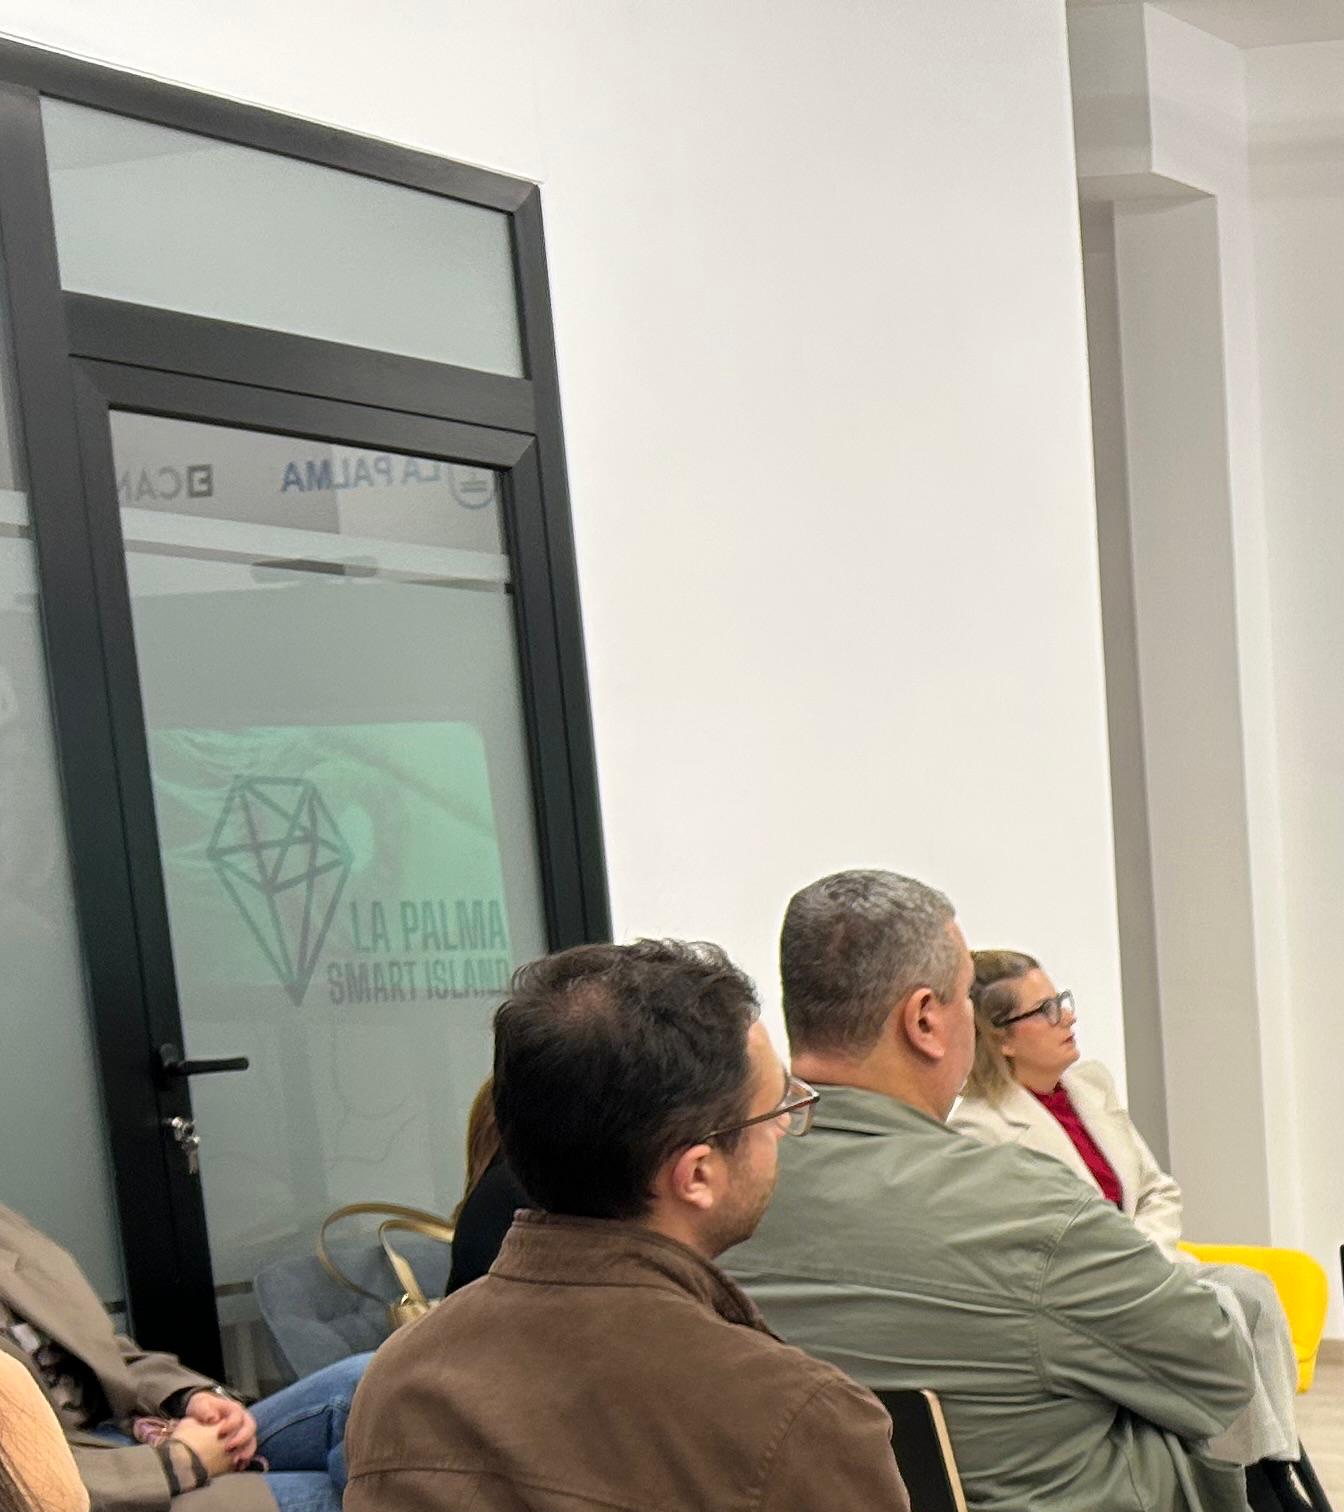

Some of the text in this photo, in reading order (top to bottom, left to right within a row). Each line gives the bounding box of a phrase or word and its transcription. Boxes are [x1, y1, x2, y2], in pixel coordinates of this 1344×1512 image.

[350, 899, 507, 953] LA PALMA
[327, 958, 417, 1004] SMART
